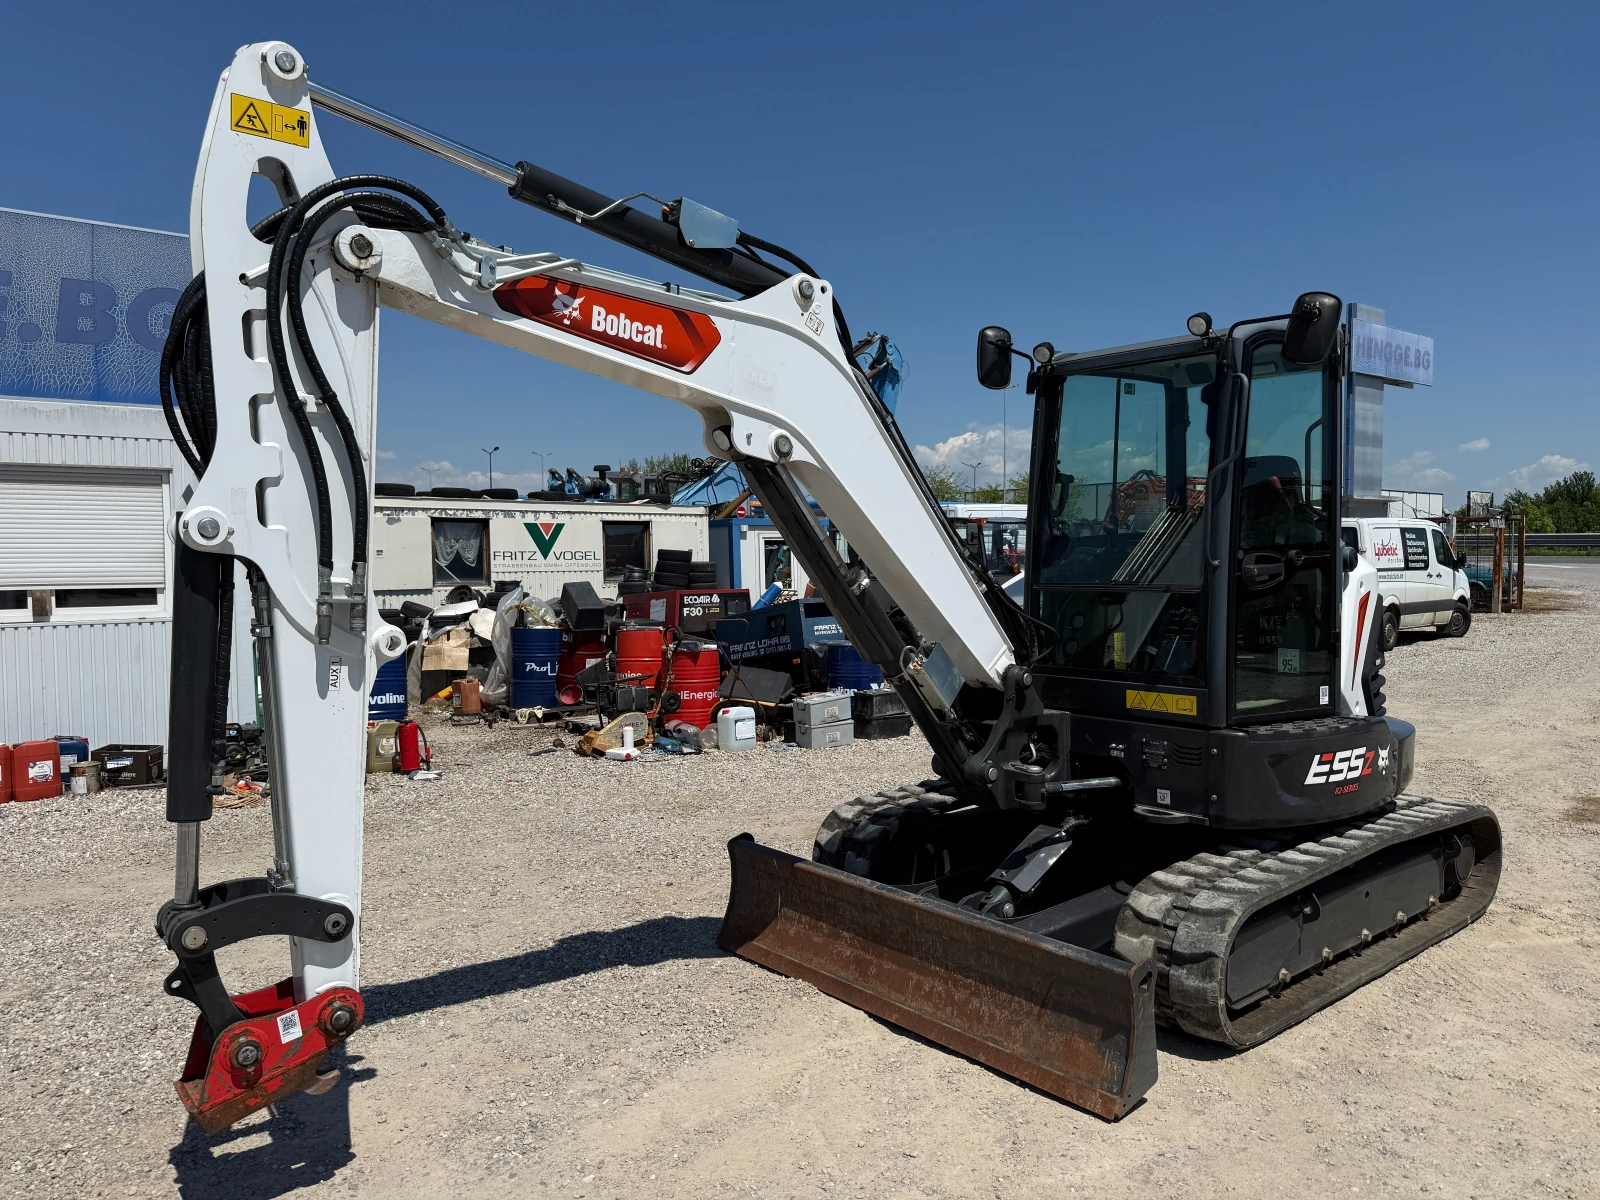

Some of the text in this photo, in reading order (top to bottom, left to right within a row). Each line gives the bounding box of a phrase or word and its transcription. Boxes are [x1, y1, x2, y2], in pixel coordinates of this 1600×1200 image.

[0, 270, 184, 353] .BG
[591, 304, 664, 349] Bobcat
[1356, 335, 1431, 371] HENGGE.BG
[493, 550, 601, 561] FRITZ VOGEL
[683, 595, 711, 604] ECOAIR
[683, 607, 703, 617] F30
[562, 632, 574, 643] bil
[1282, 659, 1293, 671] 95
[329, 667, 339, 688] AUX
[369, 692, 405, 705] voline
[678, 688, 719, 702] lEnergi
[1334, 783, 1360, 795] R2-SERIES
